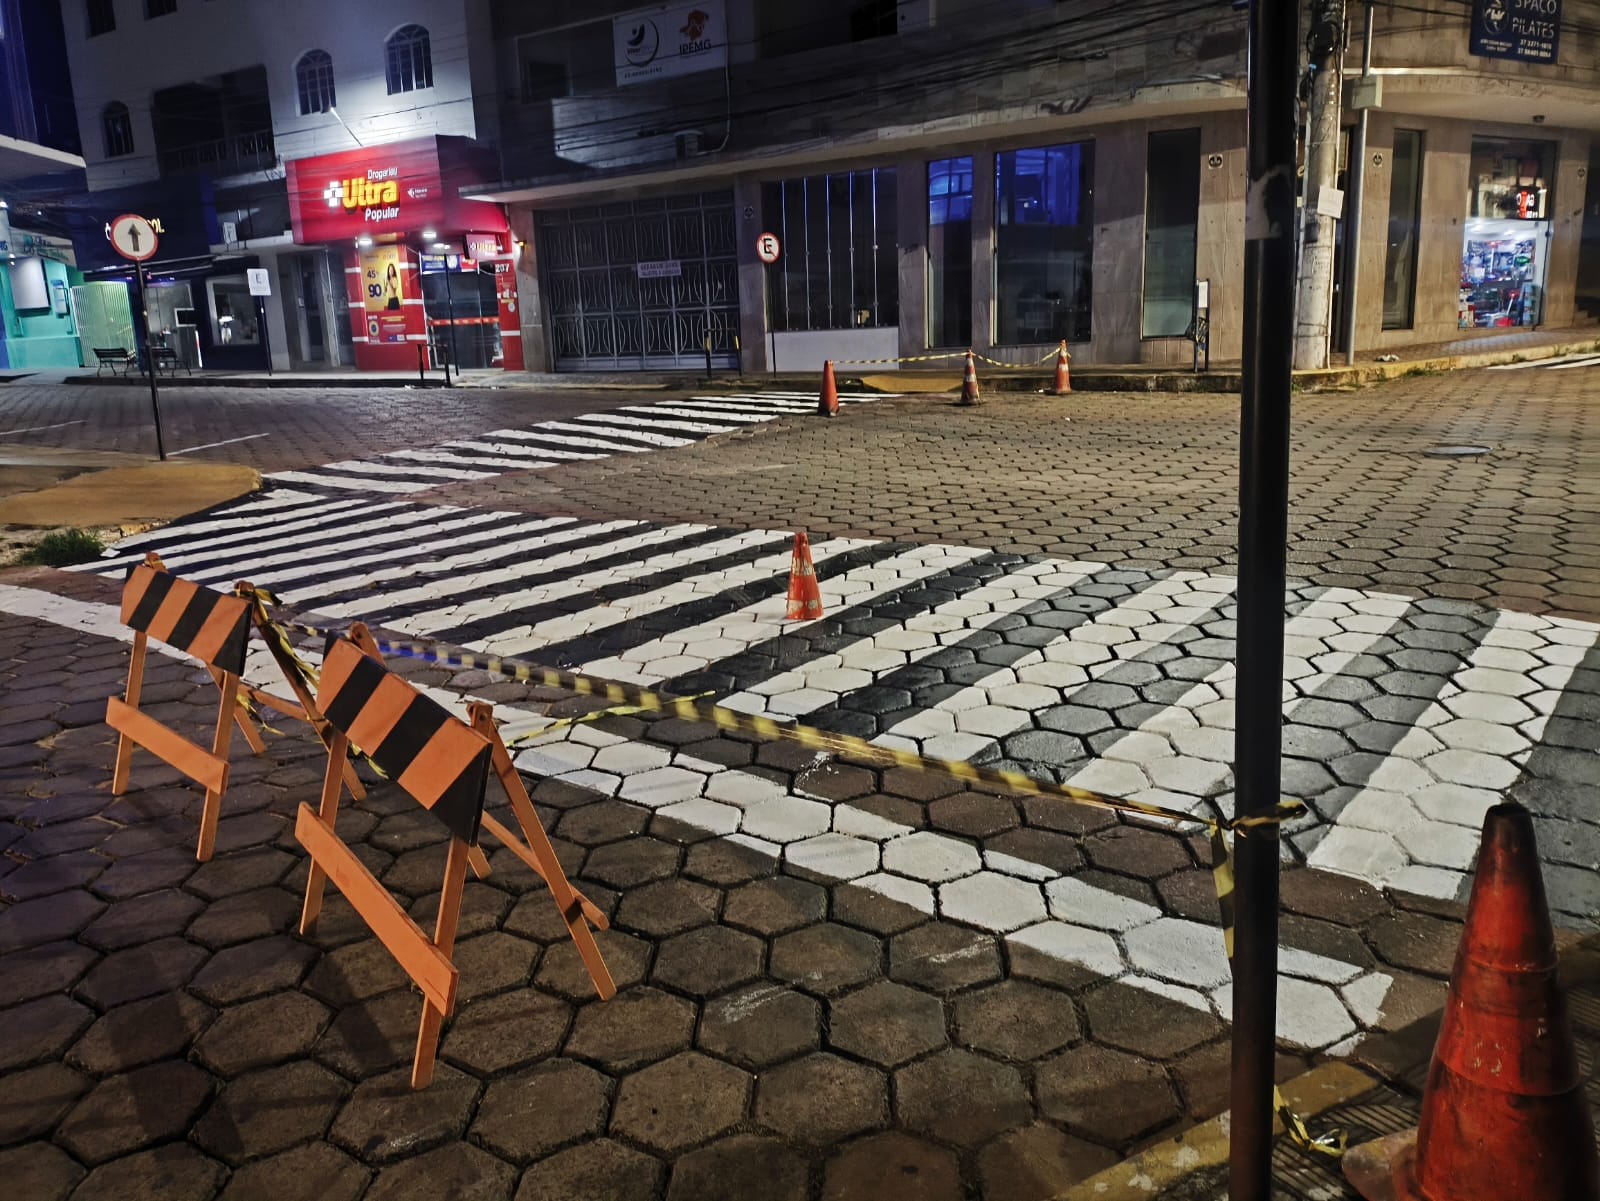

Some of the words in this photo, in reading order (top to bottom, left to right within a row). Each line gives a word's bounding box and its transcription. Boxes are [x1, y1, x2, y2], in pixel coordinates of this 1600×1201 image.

[1511, 17, 1555, 39] PILATES
[680, 39, 712, 56] IPEMG
[342, 177, 398, 208] Ultra
[364, 206, 400, 222] Popular
[763, 238, 772, 254] E
[368, 284, 382, 297] 90
